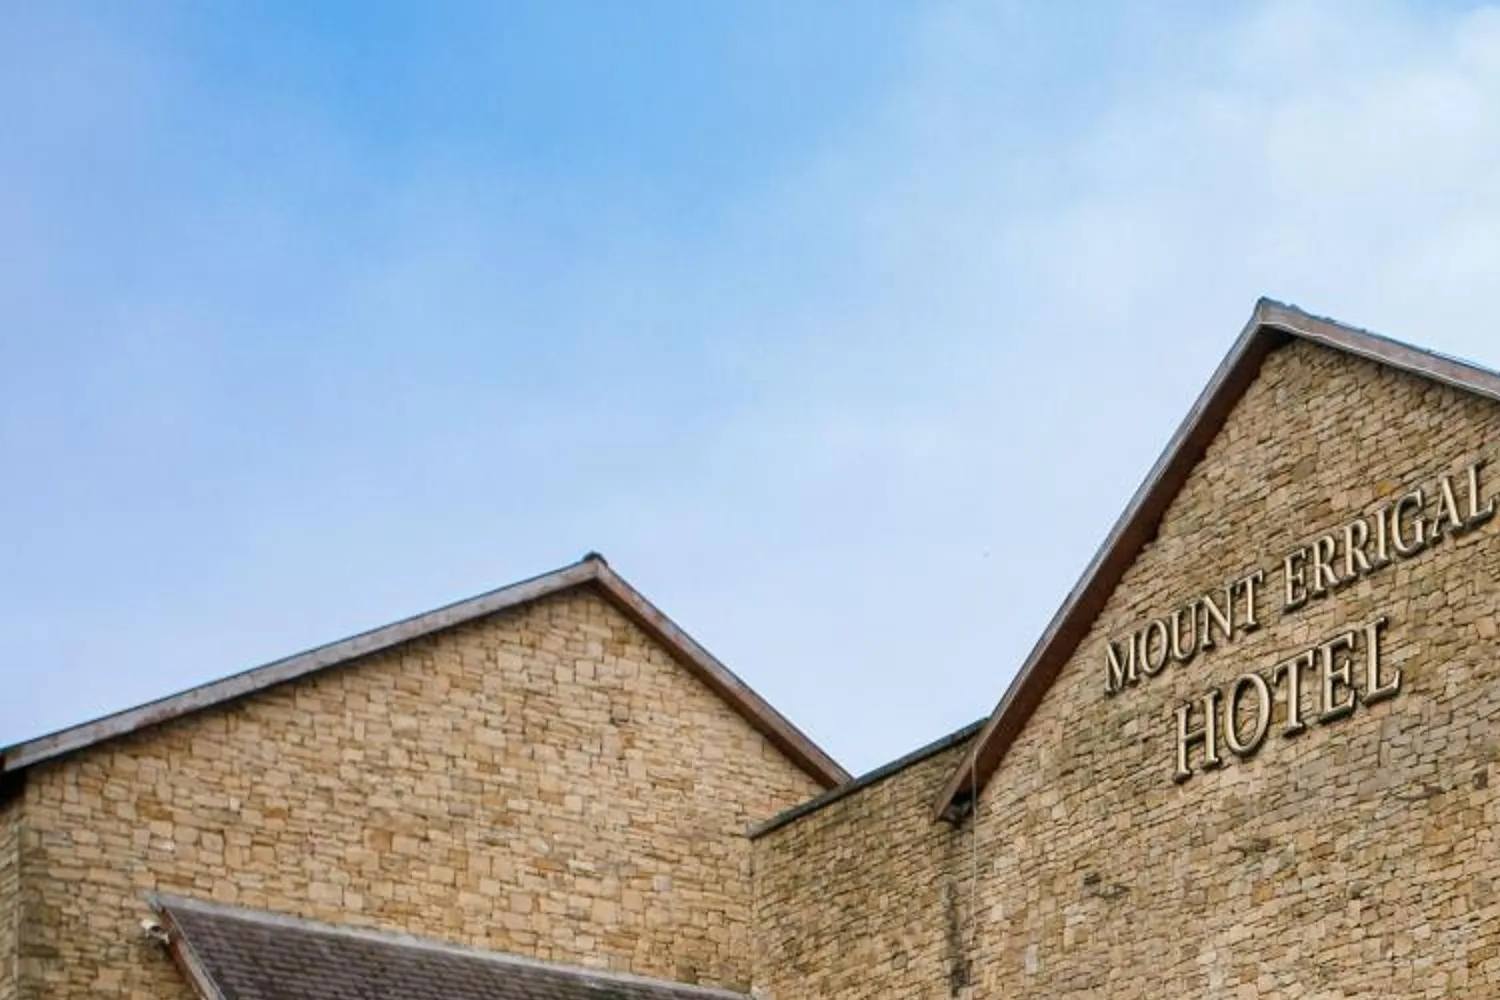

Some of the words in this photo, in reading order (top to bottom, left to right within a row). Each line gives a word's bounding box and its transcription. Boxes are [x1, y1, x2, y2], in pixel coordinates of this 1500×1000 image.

[1103, 568, 1264, 696] MOUNT
[1282, 459, 1497, 614] ERRIGAL
[1173, 616, 1401, 783] HOTEL
